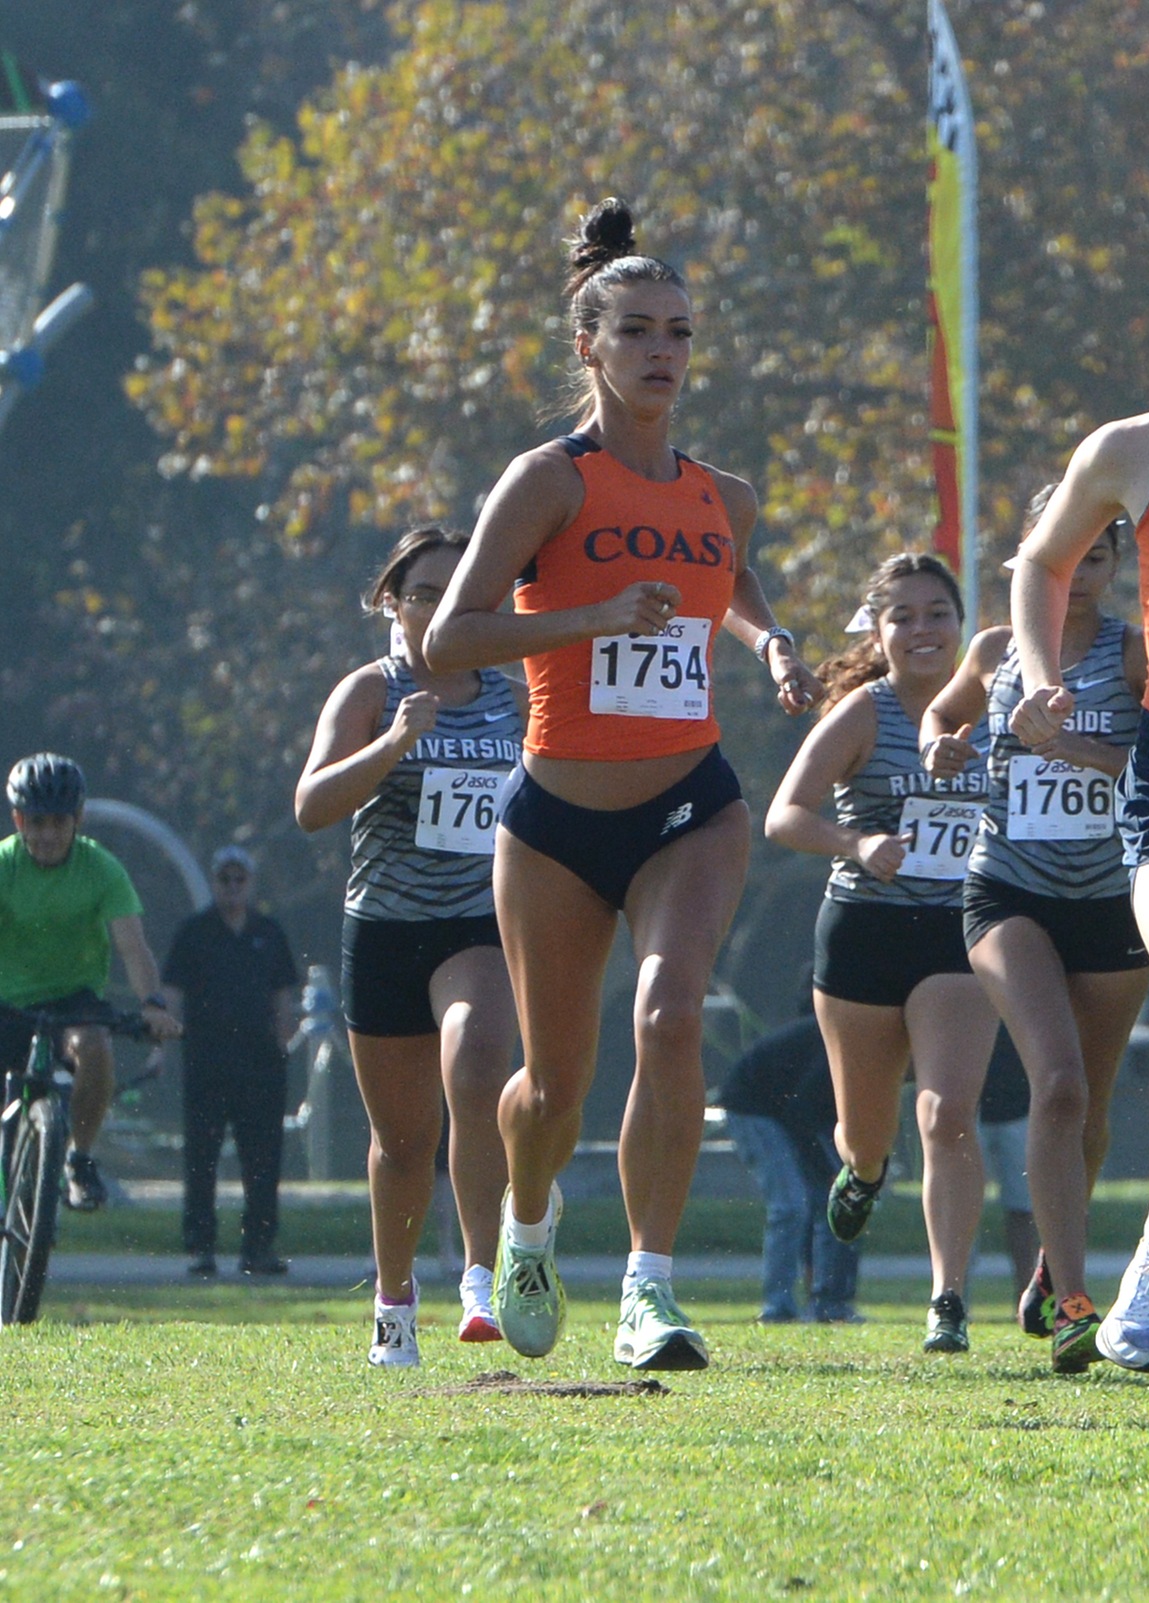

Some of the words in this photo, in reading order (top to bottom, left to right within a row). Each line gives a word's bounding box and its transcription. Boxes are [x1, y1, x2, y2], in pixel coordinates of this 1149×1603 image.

[600, 641, 706, 690] 1754
[468, 776, 498, 789] asics
[1015, 778, 1110, 815] 1766
[427, 790, 499, 830] 176
[944, 807, 977, 819] asics
[905, 819, 979, 857] 176
